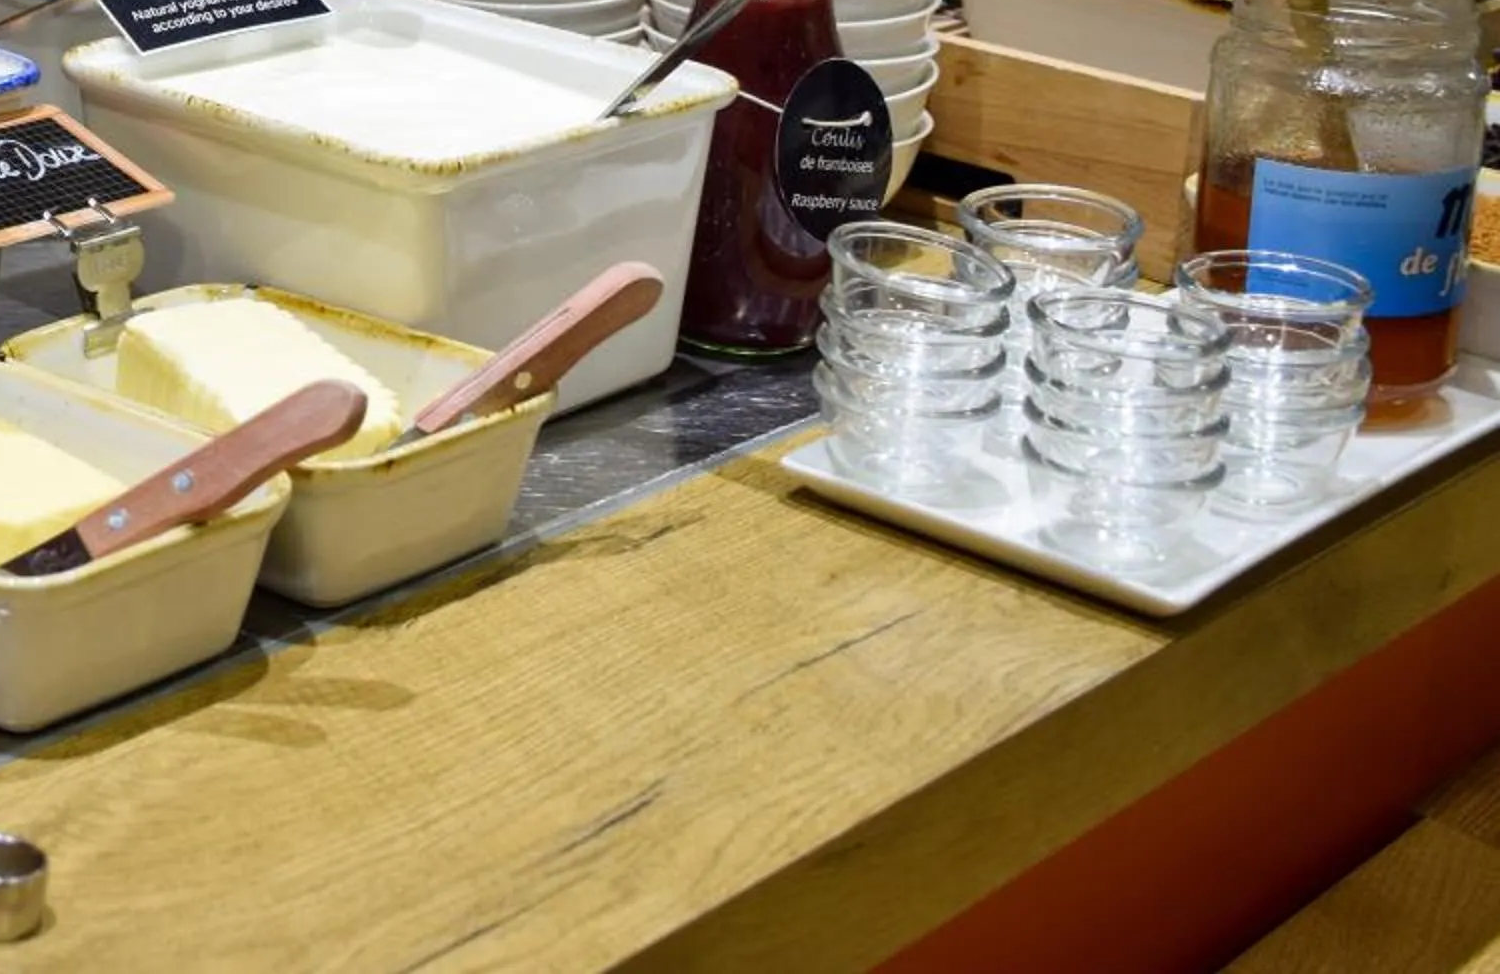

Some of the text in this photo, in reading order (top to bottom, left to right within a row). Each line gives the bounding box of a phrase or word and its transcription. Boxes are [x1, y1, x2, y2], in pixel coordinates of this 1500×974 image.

[132, 0, 177, 22] Natural
[151, 10, 215, 34] according
[214, 7, 228, 20] to
[228, 3, 255, 19] your
[811, 127, 866, 151] Coulis
[800, 153, 875, 174] de framboises
[791, 193, 879, 213] Raspberry sauce
[1400, 246, 1438, 277] de
